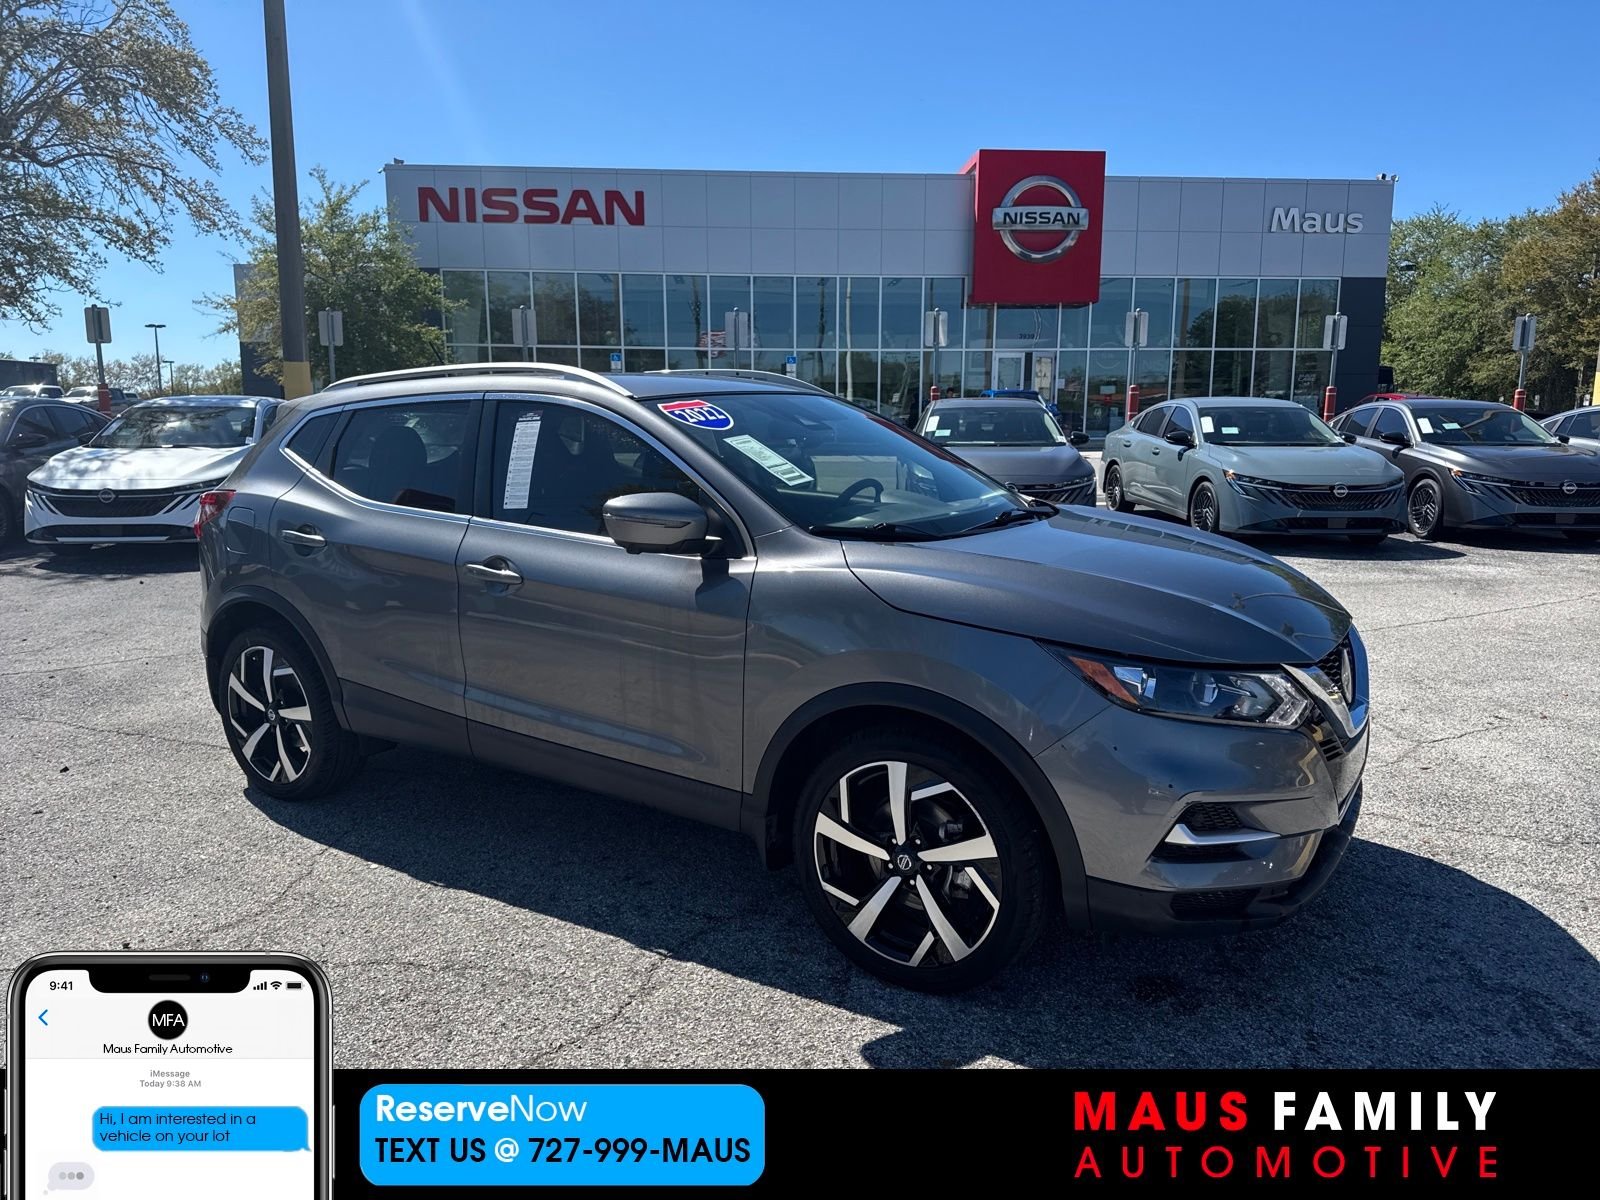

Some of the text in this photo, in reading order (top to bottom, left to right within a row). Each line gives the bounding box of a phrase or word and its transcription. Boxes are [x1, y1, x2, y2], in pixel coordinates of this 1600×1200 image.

[417, 186, 645, 226] NISSAN
[1003, 211, 1080, 226] NISSAN
[1270, 207, 1364, 234] Maus
[675, 406, 727, 423] 2022
